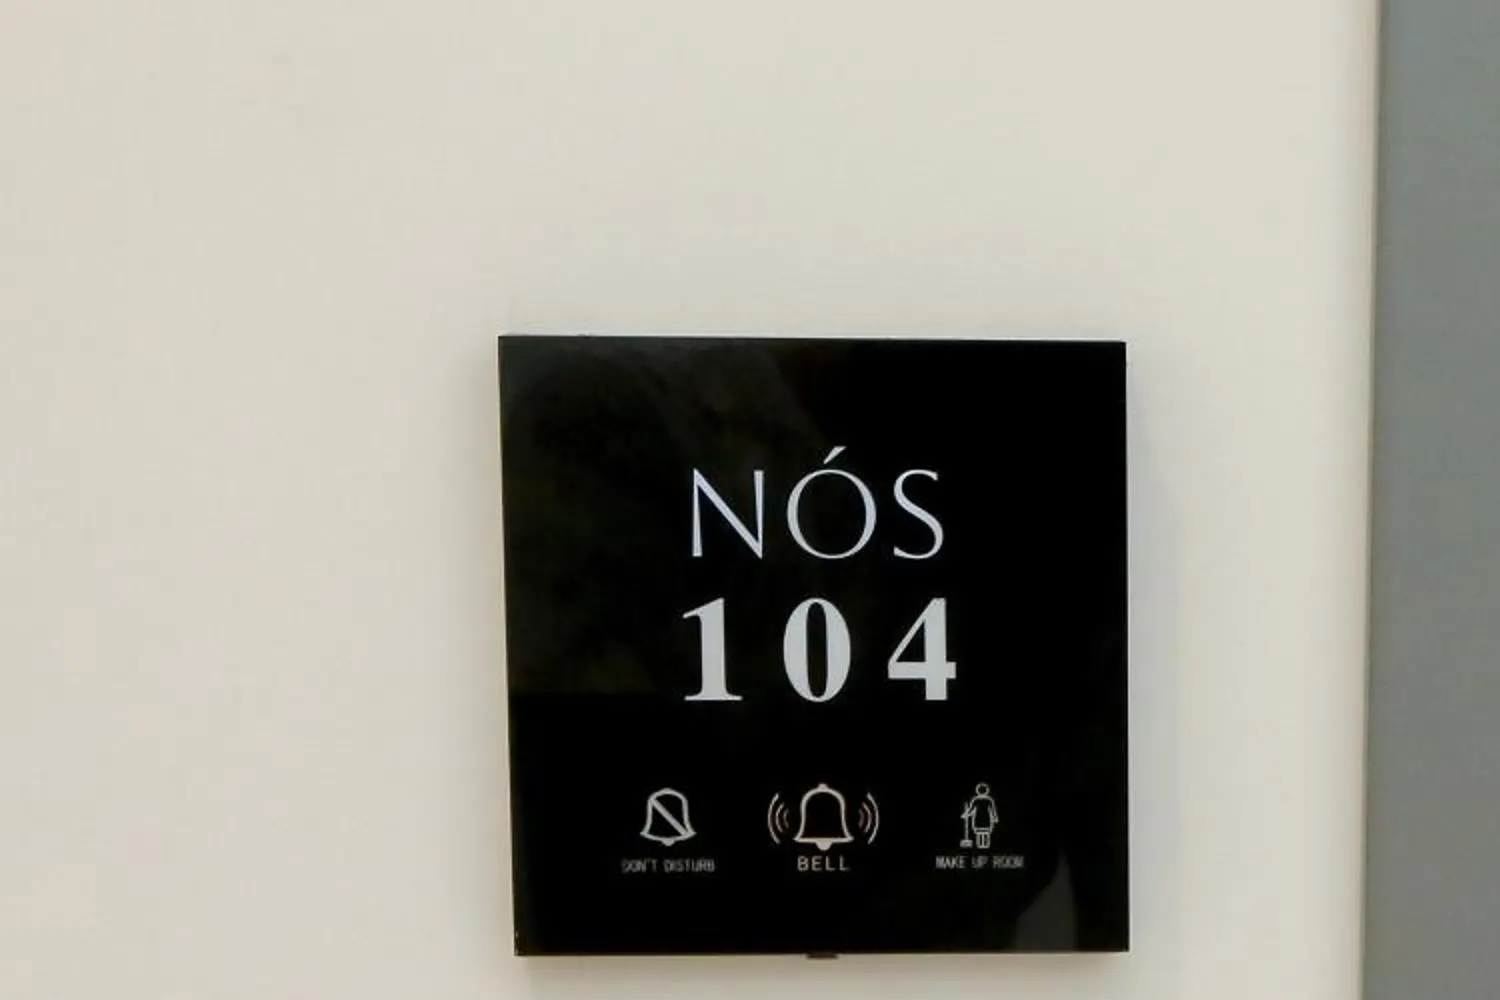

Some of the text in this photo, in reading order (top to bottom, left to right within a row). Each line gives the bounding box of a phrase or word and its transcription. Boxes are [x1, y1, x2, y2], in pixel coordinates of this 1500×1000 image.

[691, 446, 945, 561] NÓS
[682, 596, 958, 704] 104
[621, 858, 716, 873] DON'T DISTURB
[797, 855, 851, 871] BELL
[936, 855, 1024, 869] MAKE UP ROOM
